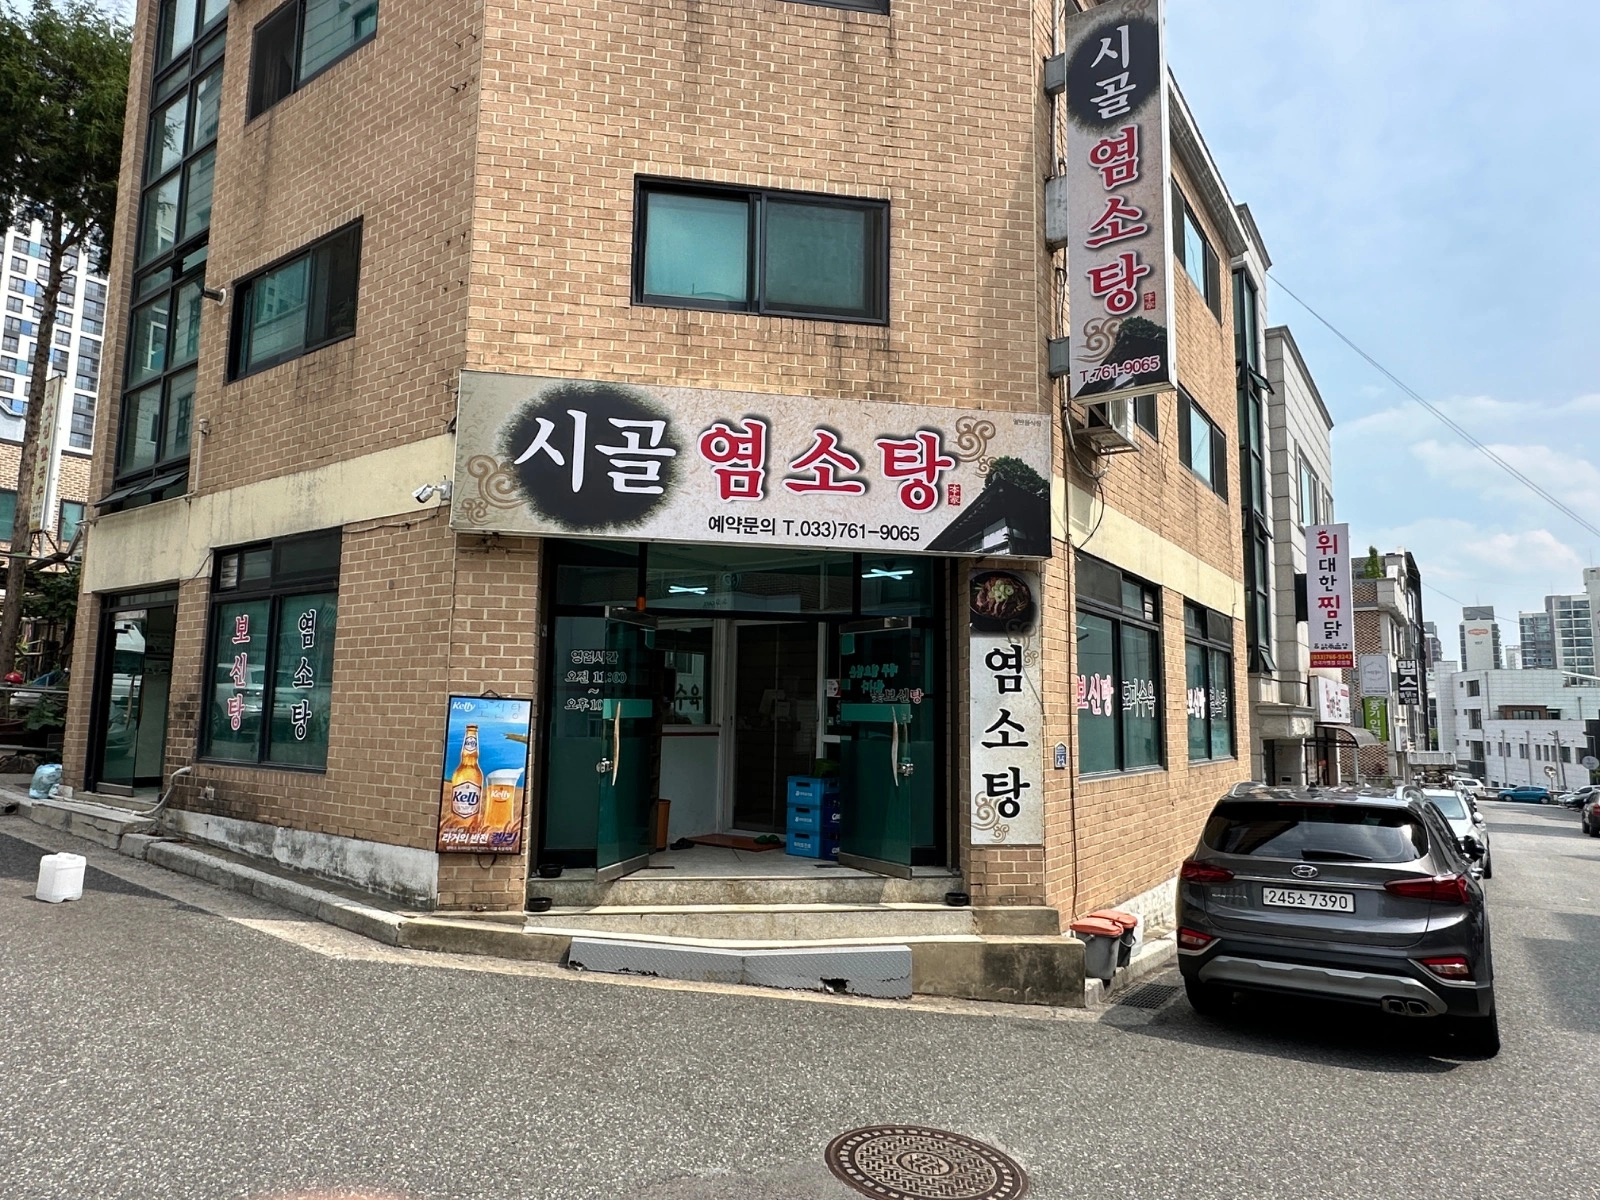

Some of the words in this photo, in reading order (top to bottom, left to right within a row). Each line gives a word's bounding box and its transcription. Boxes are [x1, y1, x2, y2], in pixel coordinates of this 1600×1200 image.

[1089, 25, 1137, 119] 시골
[1085, 125, 1148, 316] 염소탕
[1079, 357, 1160, 385] T.761-9065
[513, 409, 677, 495] 시골
[696, 418, 957, 512] 염소탕
[708, 515, 777, 537] 예약문의
[784, 520, 920, 543] T.033)761-9065
[570, 650, 619, 664] 영업시간
[227, 613, 251, 732] 보신탕
[289, 608, 317, 741] 염소탕
[564, 670, 589, 684] 오전
[452, 701, 476, 713] Kelly
[564, 698, 589, 712] 오후
[1077, 673, 1114, 717] 보신탕
[981, 644, 1031, 819] 염소탕
[452, 791, 480, 806] Kelly
[491, 789, 511, 801] Kelly
[1268, 890, 1306, 905] 245소
[1309, 893, 1348, 909] 7390
